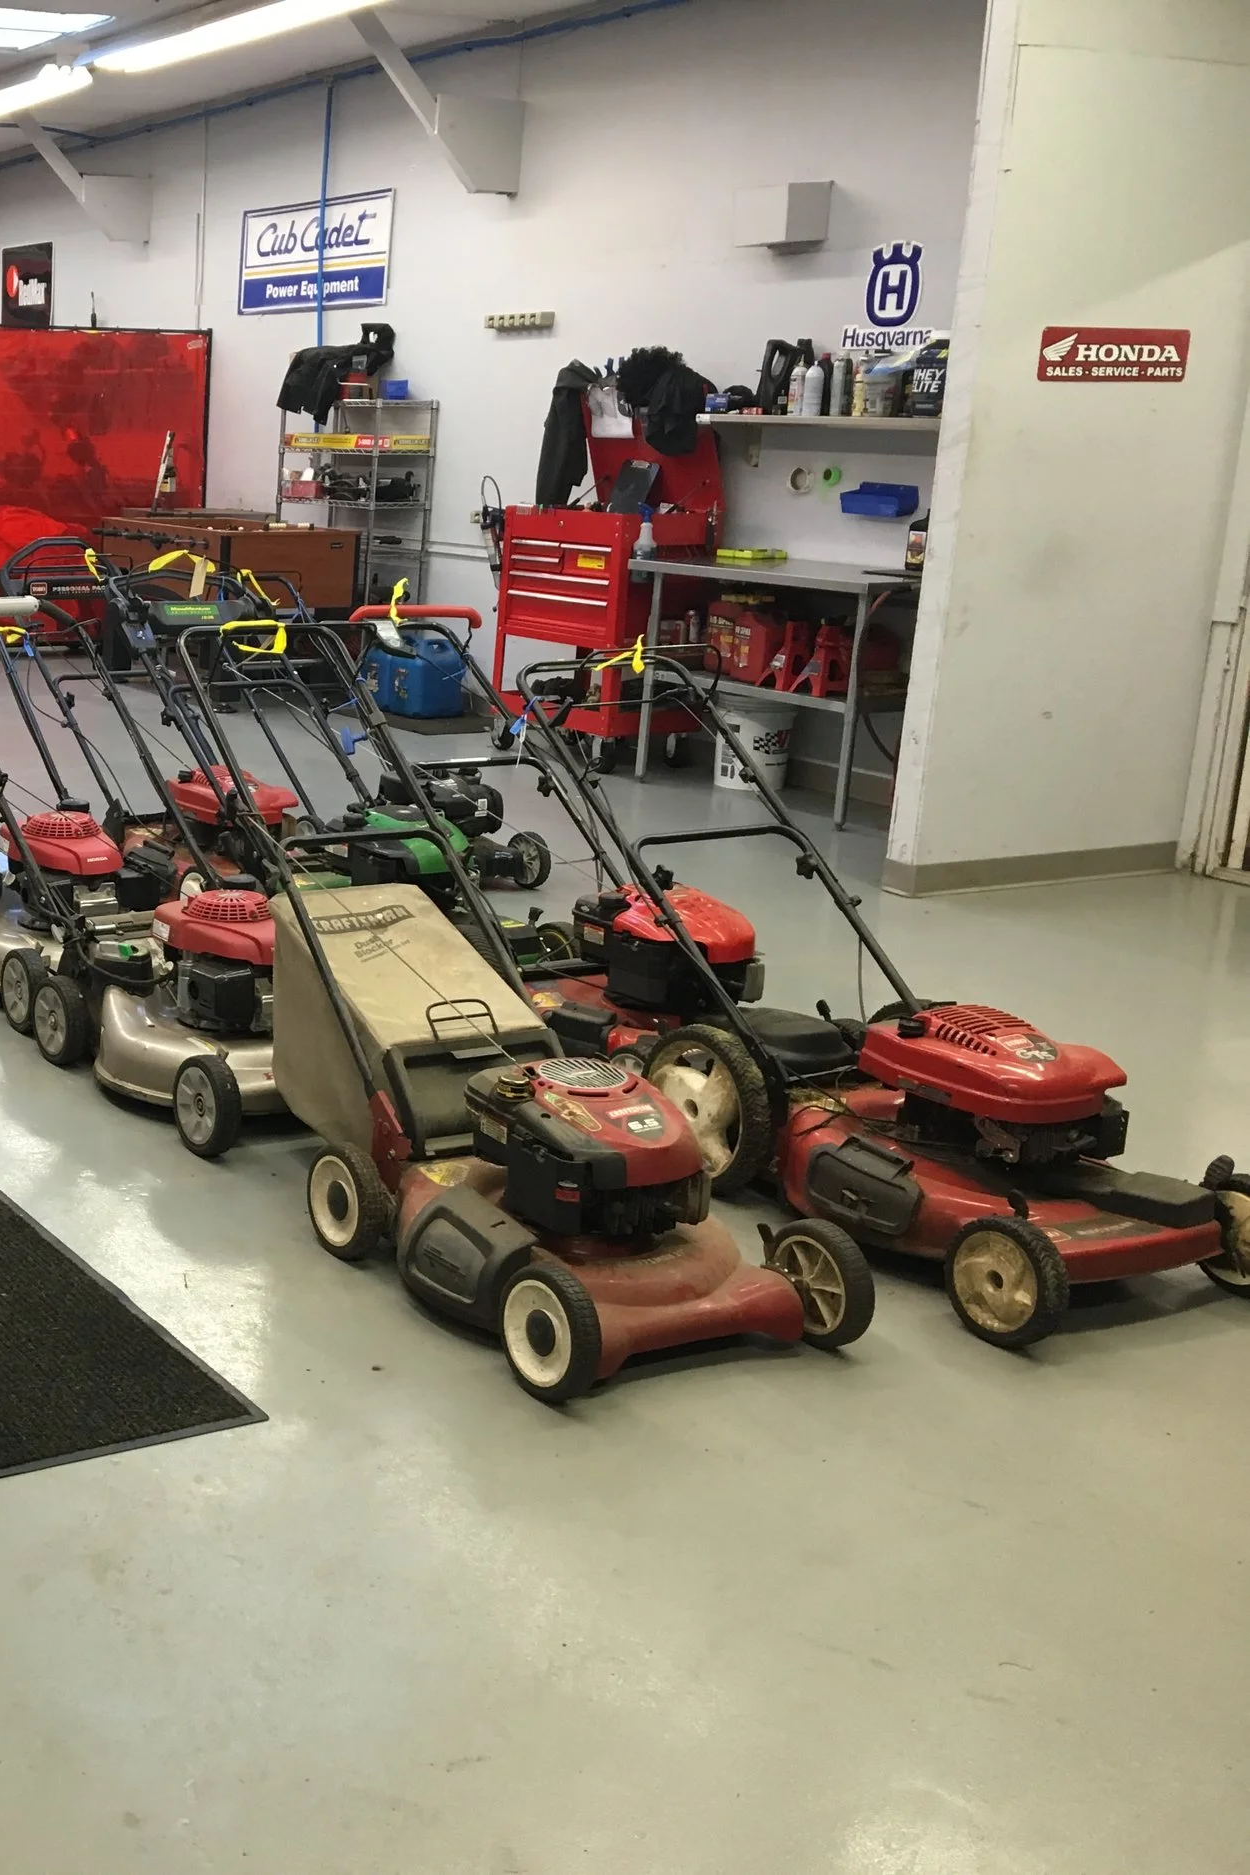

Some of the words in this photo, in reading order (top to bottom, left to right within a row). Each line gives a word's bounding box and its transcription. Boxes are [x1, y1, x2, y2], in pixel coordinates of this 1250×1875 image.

[256, 219, 298, 258] Cub
[265, 283, 299, 299] Power
[300, 275, 360, 299] Equpment
[1074, 343, 1181, 362] HONDA
[1046, 366, 1083, 377] SALES
[1091, 366, 1139, 377] SERVICE
[1146, 366, 1183, 377] PARTS
[312, 906, 409, 932] CRAFTSMAN
[1015, 1049, 1056, 1061] GTS
[627, 1118, 660, 1131] 6.5
